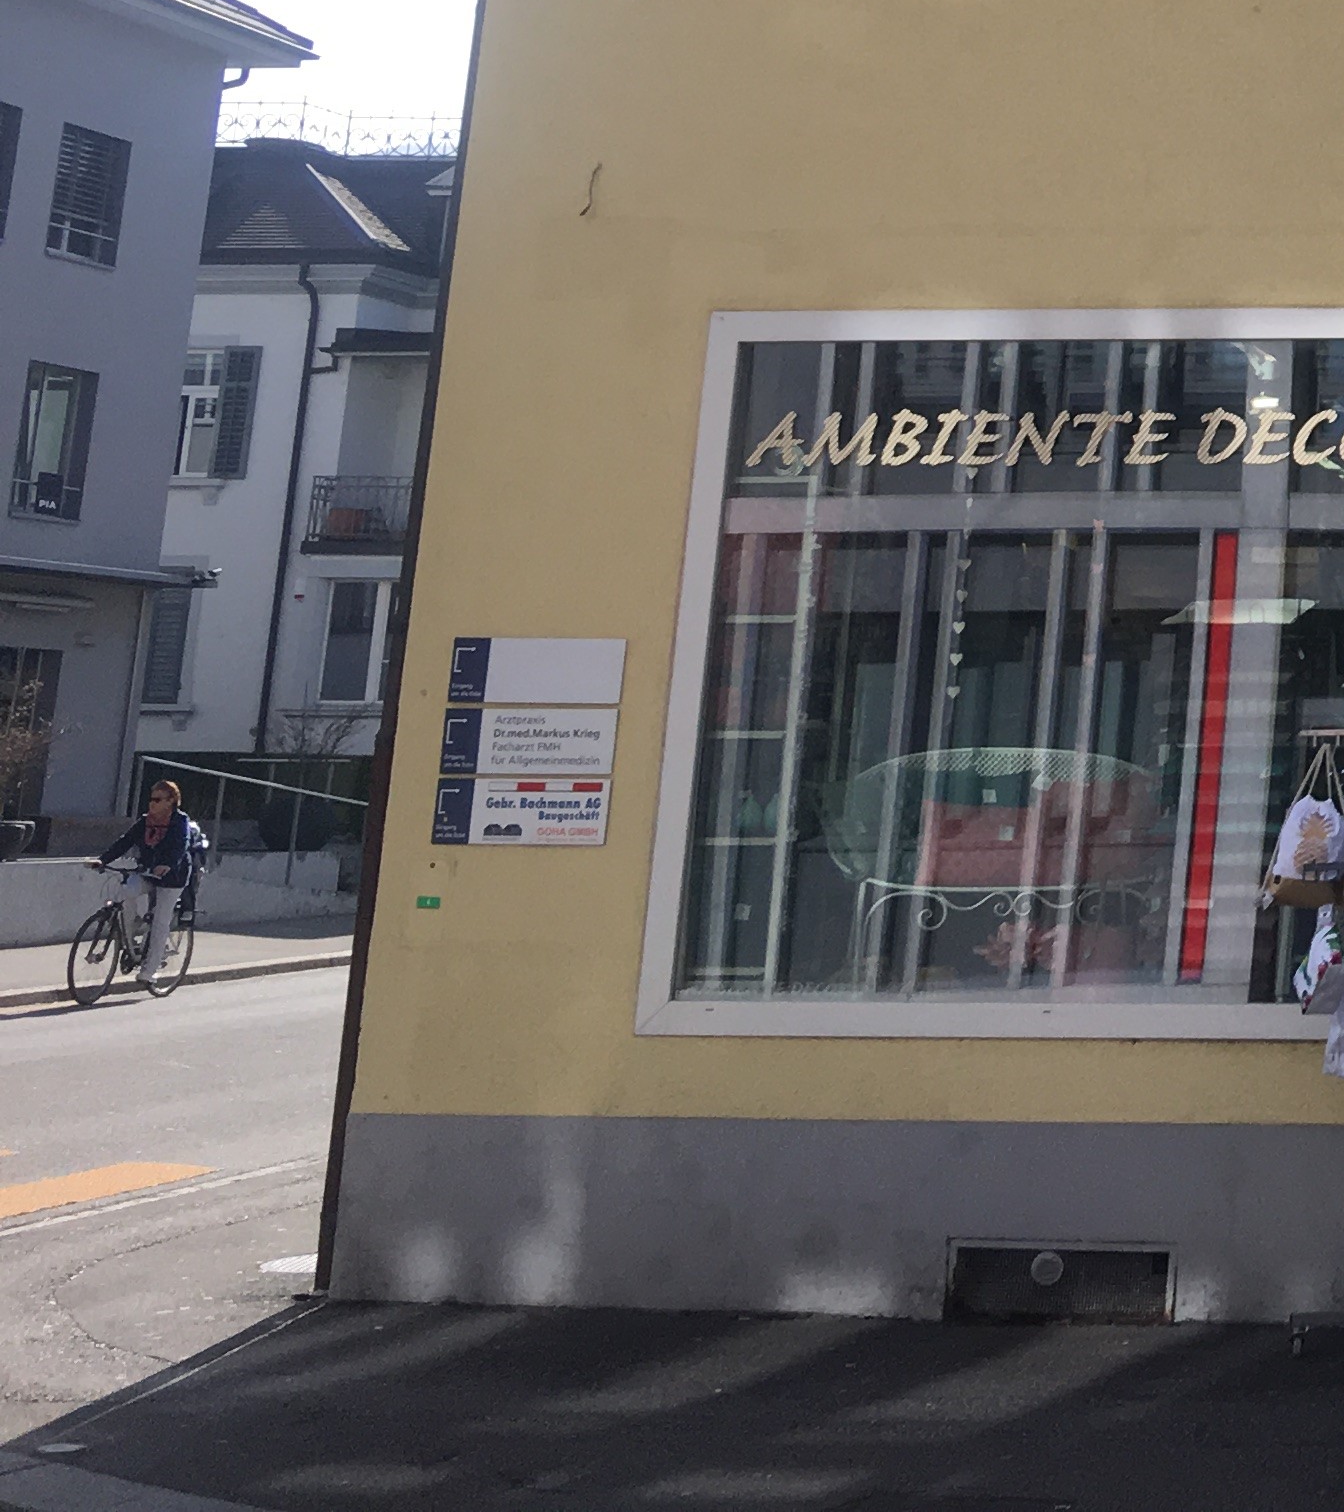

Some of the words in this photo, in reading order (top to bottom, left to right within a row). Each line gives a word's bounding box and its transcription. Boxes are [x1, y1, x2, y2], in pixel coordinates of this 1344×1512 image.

[745, 407, 1178, 467] AMBIENTE
[38, 499, 57, 510] PIA
[494, 715, 546, 726] Arztpraxis
[573, 728, 600, 740] Krieg
[491, 742, 534, 751] Facharzt
[537, 742, 561, 751] FMH
[508, 756, 601, 767] Allgemeinmedizin
[486, 797, 516, 809] Gebr.
[520, 797, 581, 809] Bachmann
[585, 797, 602, 809] AG
[538, 810, 600, 823] Baugeschäft
